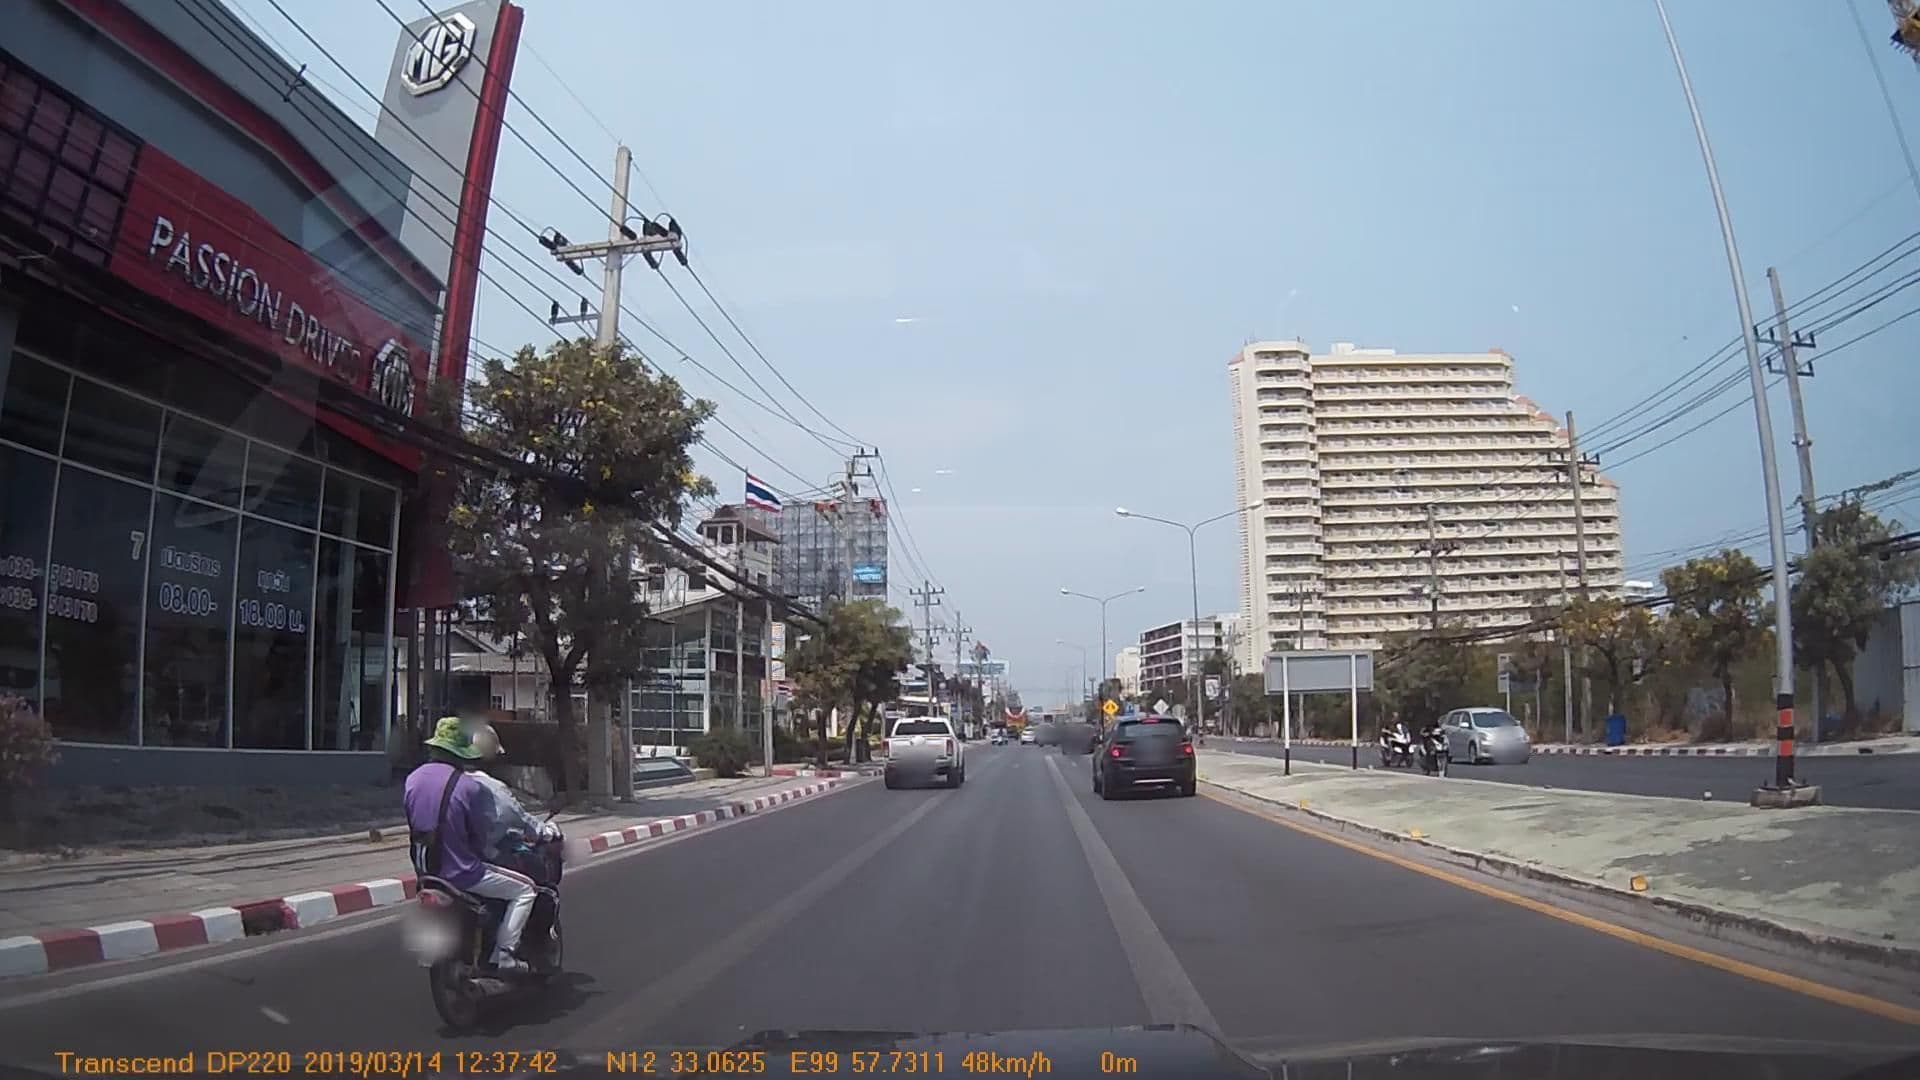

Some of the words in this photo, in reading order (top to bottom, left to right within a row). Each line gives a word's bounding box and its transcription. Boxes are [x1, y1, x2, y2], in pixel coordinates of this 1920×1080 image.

[406, 20, 465, 86] MG
[150, 215, 283, 330] PASSION
[160, 582, 217, 616] 08.00-
[240, 599, 286, 630] 18.00
